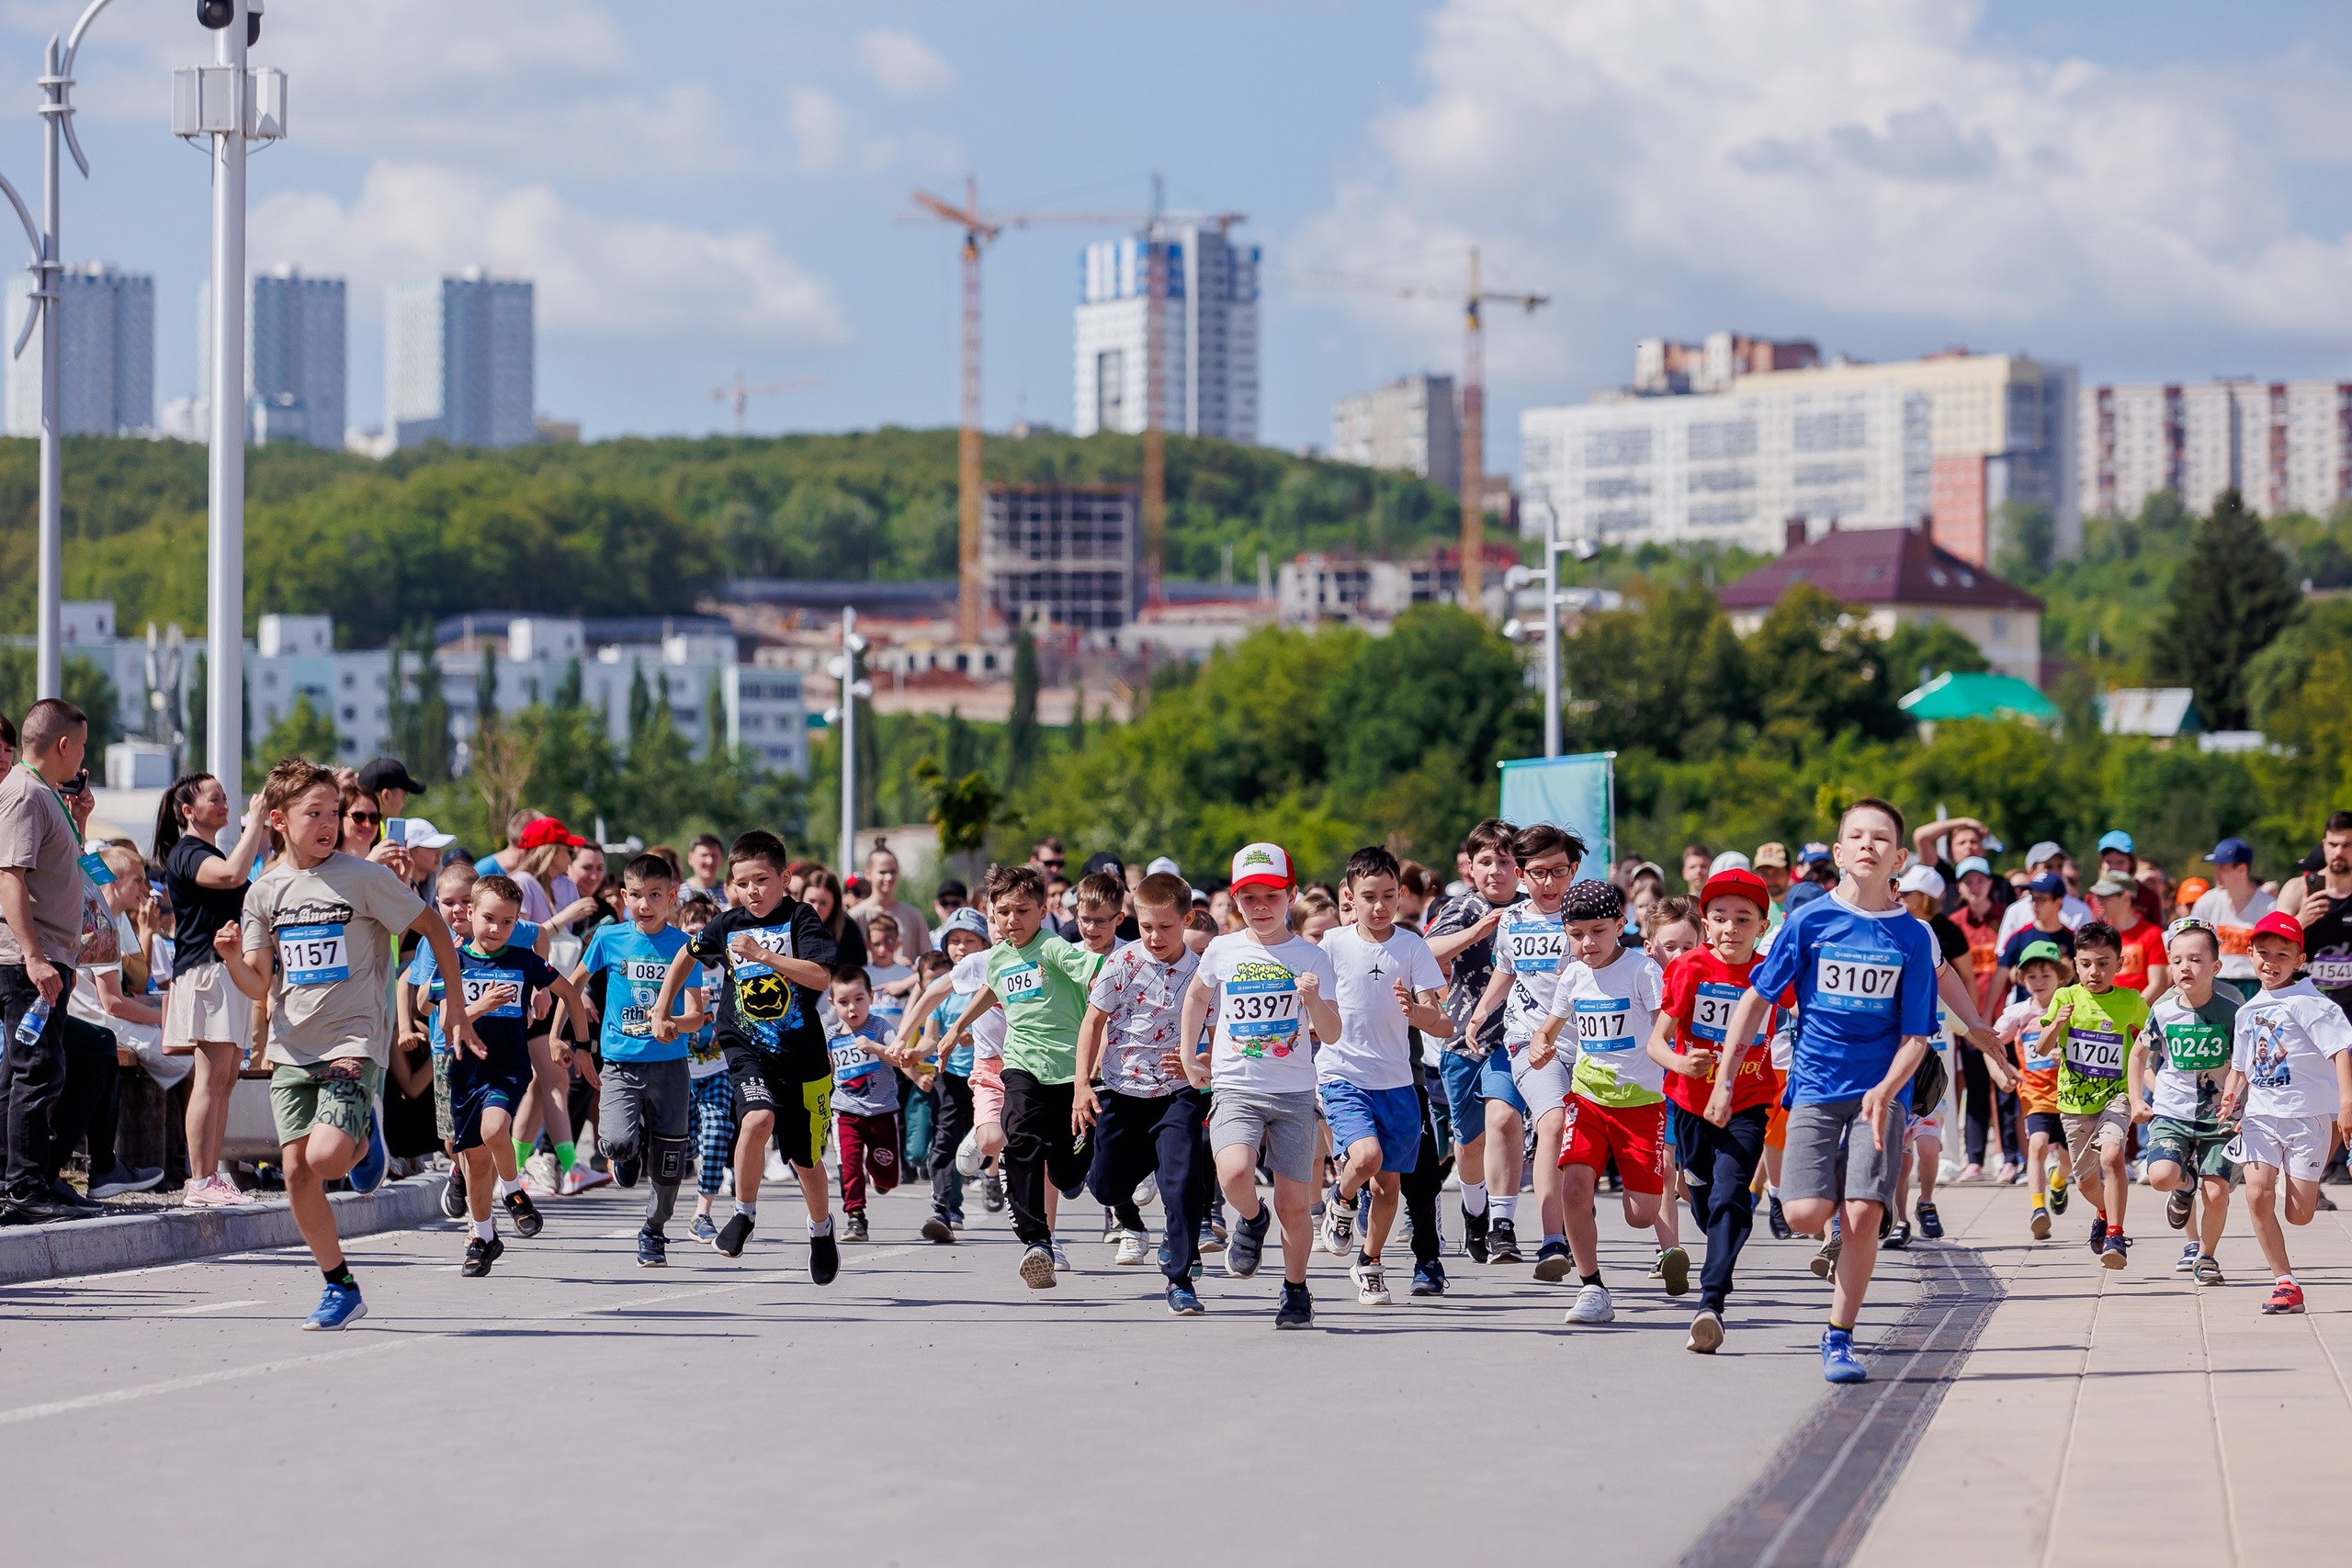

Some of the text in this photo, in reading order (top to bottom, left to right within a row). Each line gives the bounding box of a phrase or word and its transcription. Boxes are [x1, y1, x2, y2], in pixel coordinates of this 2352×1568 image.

[284, 940, 338, 967] 3157
[1513, 935, 1562, 956] 3034
[636, 964, 665, 980] 082
[1007, 973, 1032, 992] 096
[1825, 964, 1894, 994] 3107
[1233, 994, 1293, 1021] 3397
[1578, 1013, 1625, 1037] 3017
[2073, 1042, 2120, 1066] 1704
[2171, 1037, 2222, 1057] 0243
